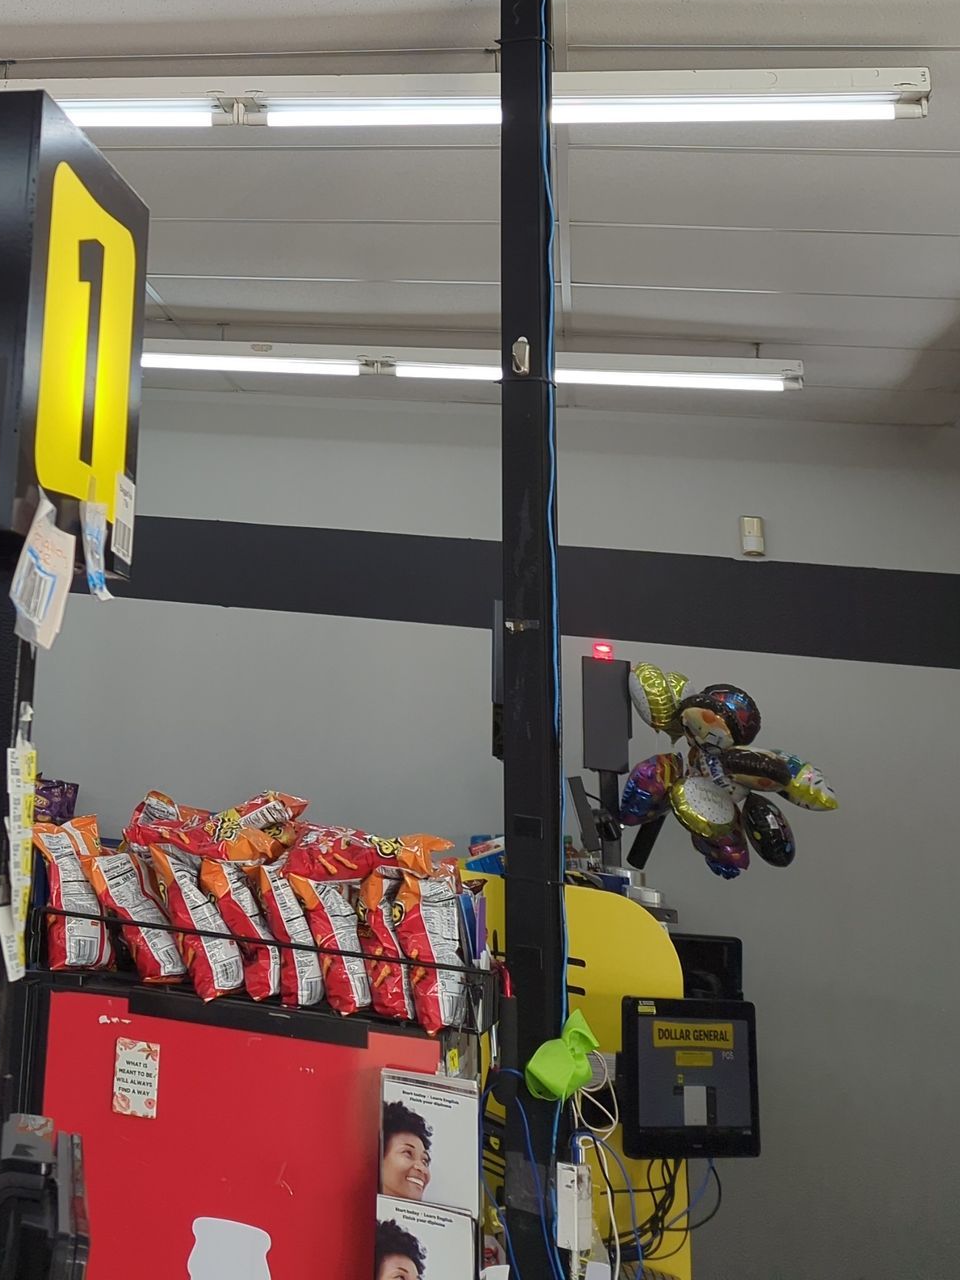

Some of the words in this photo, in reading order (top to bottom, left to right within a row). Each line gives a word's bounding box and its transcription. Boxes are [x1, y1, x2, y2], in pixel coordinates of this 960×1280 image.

[78, 238, 105, 466] 1
[658, 1028, 690, 1040] DOLLAR
[692, 1028, 730, 1042] GENERAL
[118, 1068, 136, 1076] MEANT
[130, 1080, 152, 1088] ALWAYS
